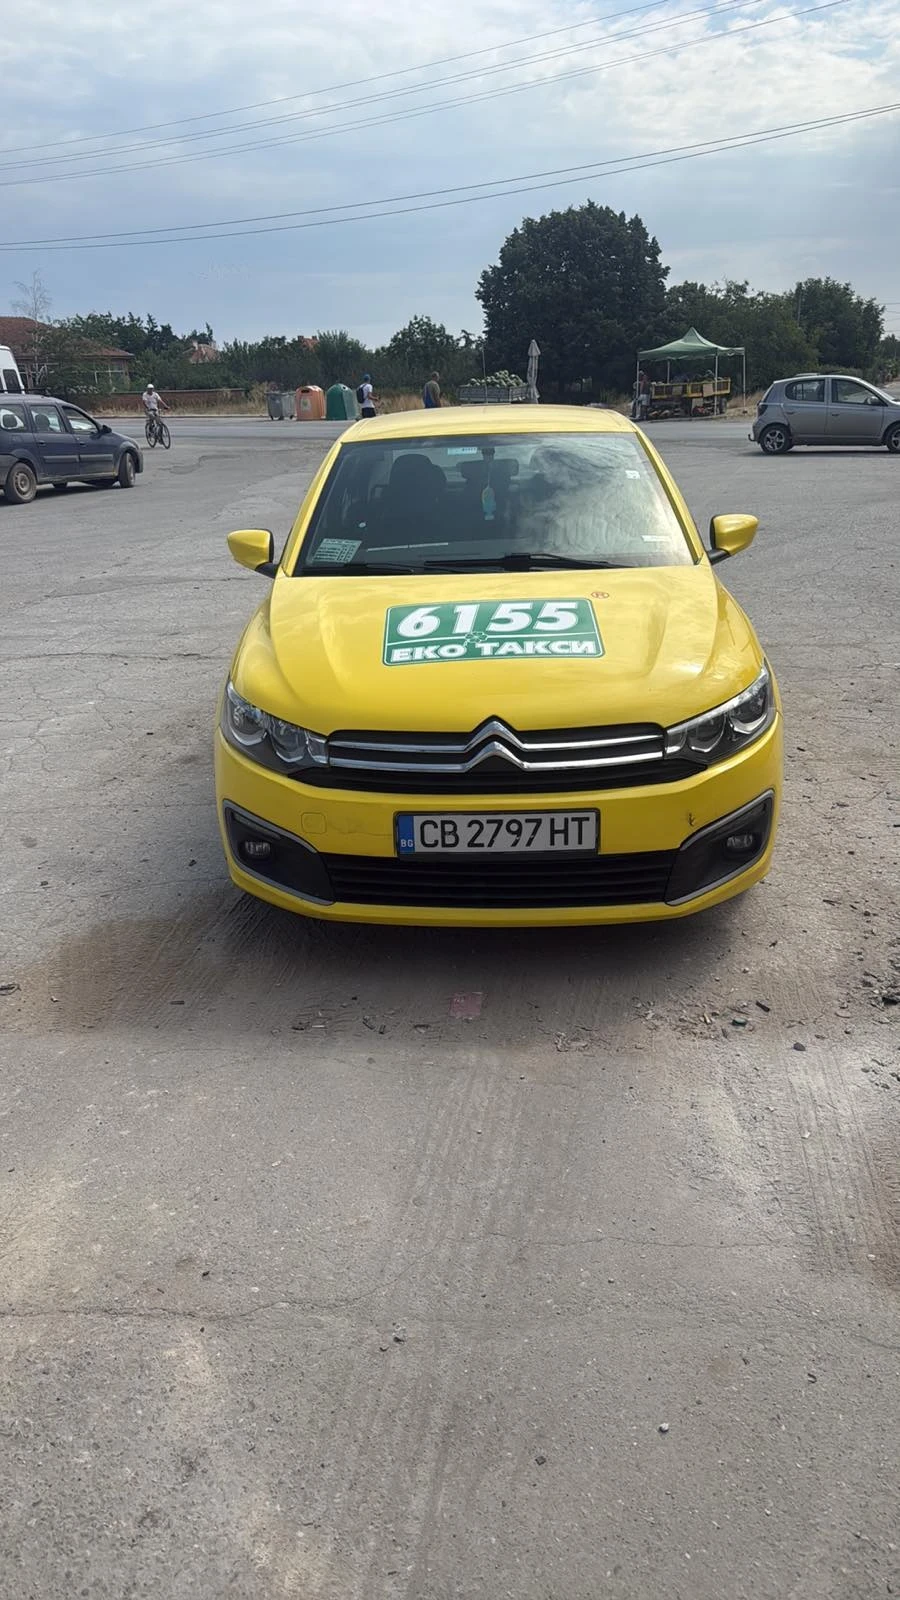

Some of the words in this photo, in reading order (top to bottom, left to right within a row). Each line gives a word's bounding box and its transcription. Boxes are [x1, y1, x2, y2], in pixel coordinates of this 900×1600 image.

[396, 601, 580, 638] 6155
[390, 644, 468, 663] ЕКО
[474, 640, 598, 656] ТАКСИ
[400, 838, 414, 848] BG
[420, 819, 460, 849] CB
[467, 817, 543, 848] 2797
[549, 816, 590, 846] HT
